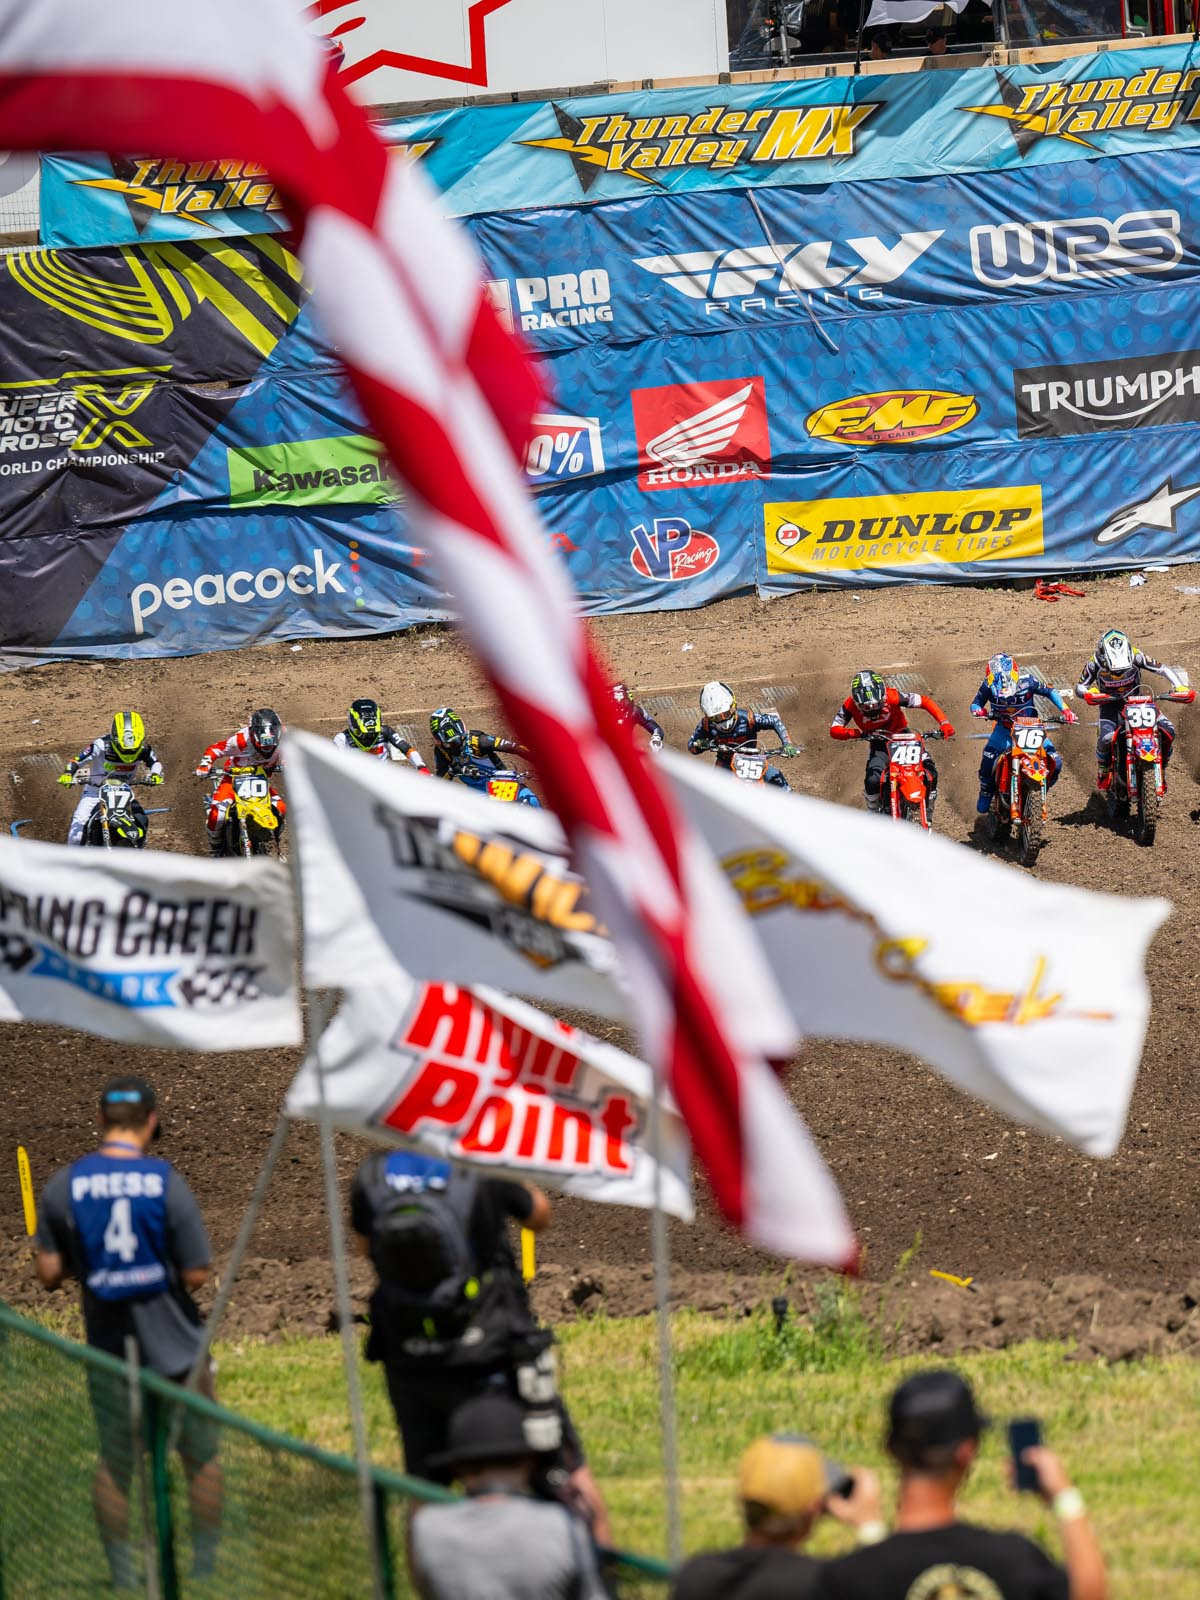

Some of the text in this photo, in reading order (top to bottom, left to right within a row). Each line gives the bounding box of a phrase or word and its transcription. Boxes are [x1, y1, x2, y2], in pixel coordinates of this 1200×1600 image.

[1044, 99, 1184, 135] Valley
[575, 103, 879, 161] Thunder MX
[606, 137, 746, 171] Valley
[631, 209, 1184, 300] FLY WPS
[515, 268, 611, 313] PRO
[705, 287, 884, 316] RACING
[520, 305, 614, 332] RACING
[0, 390, 80, 417] UPER
[808, 394, 976, 438] FMF
[0, 429, 80, 454] ROSS
[521, 430, 585, 478] 0%
[0, 451, 166, 477] ORLD CHAMPIONSHIP
[646, 461, 764, 486] HONDA
[816, 506, 1033, 545] DUNLOP
[631, 516, 692, 580] VP
[673, 547, 715, 573] Racing
[810, 534, 1016, 561] MOTORCYCLE TIRES
[130, 548, 347, 636] peacock
[1127, 706, 1157, 728] 39
[1015, 729, 1045, 749] 16
[891, 745, 921, 765] 48
[736, 759, 764, 780] 35
[106, 791, 131, 809] 17
[237, 779, 268, 799] 40
[491, 781, 519, 801] 38
[383, 1059, 634, 1172] Point
[71, 1171, 163, 1202] PRESS
[103, 1197, 139, 1263] 4
